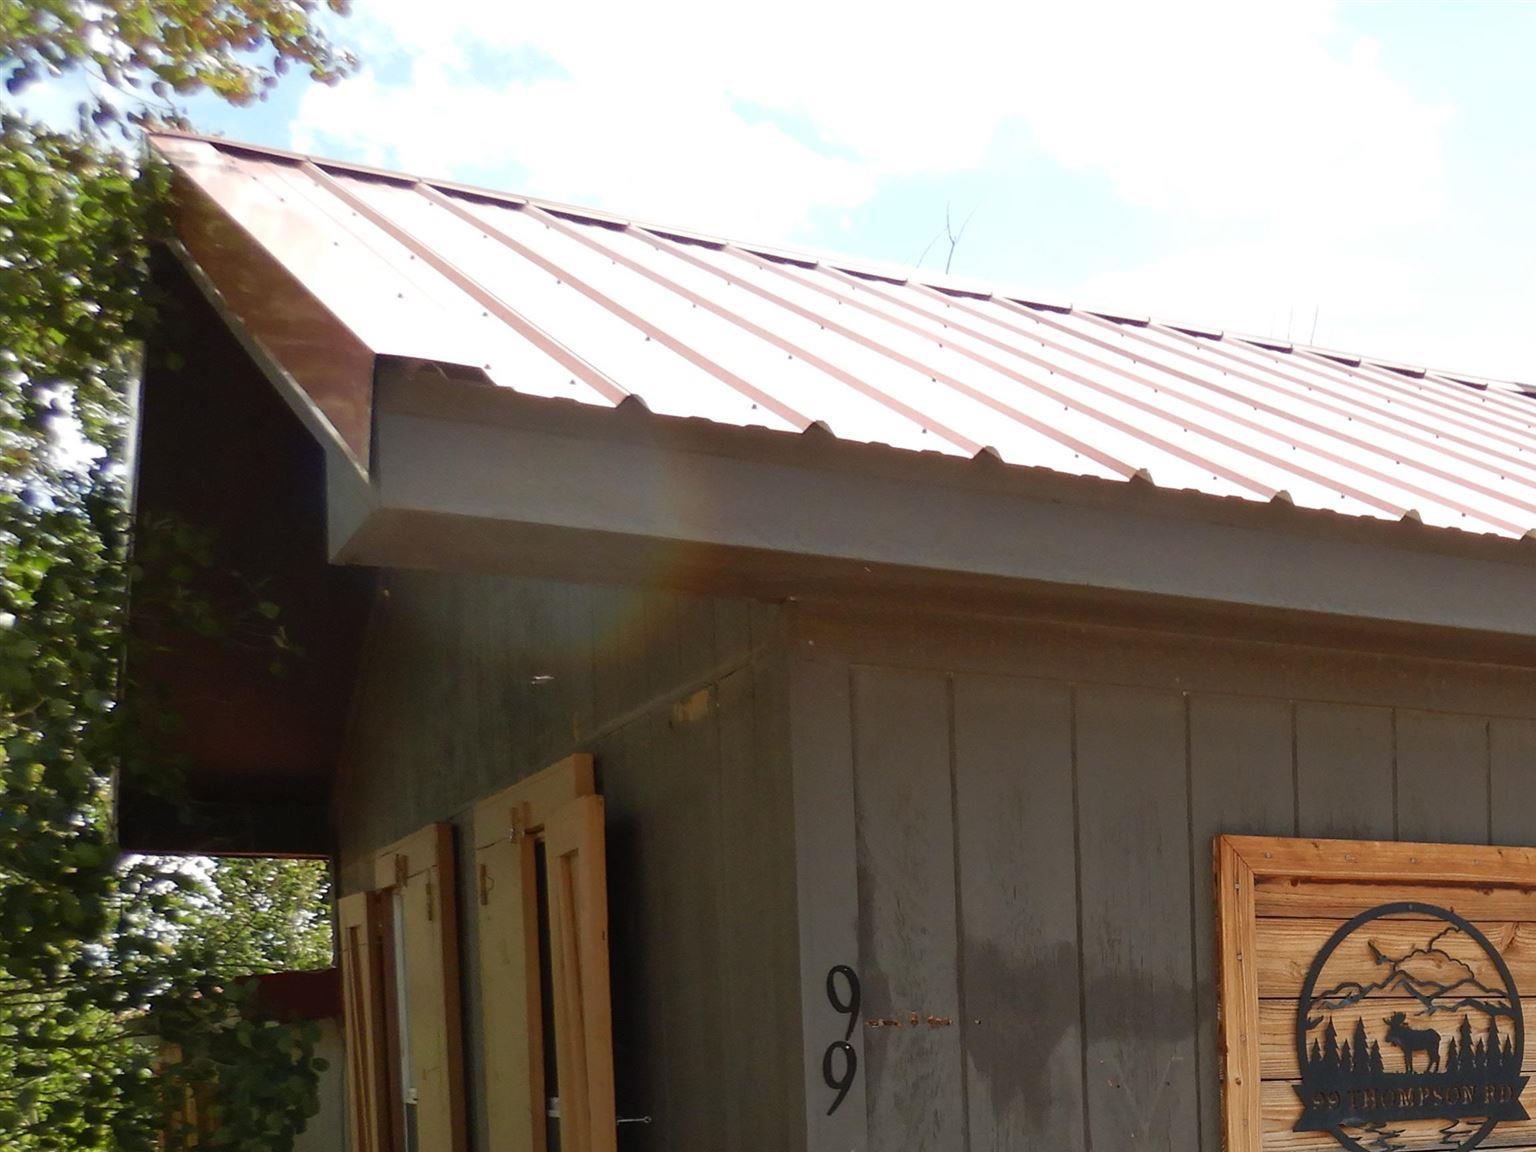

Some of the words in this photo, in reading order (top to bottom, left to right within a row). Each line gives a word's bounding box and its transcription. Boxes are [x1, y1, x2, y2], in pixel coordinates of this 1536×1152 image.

[823, 965, 861, 1116] 99
[1312, 1090, 1341, 1110] 99
[1347, 1085, 1475, 1110] THOMPSON
[1484, 1085, 1513, 1104] RD
